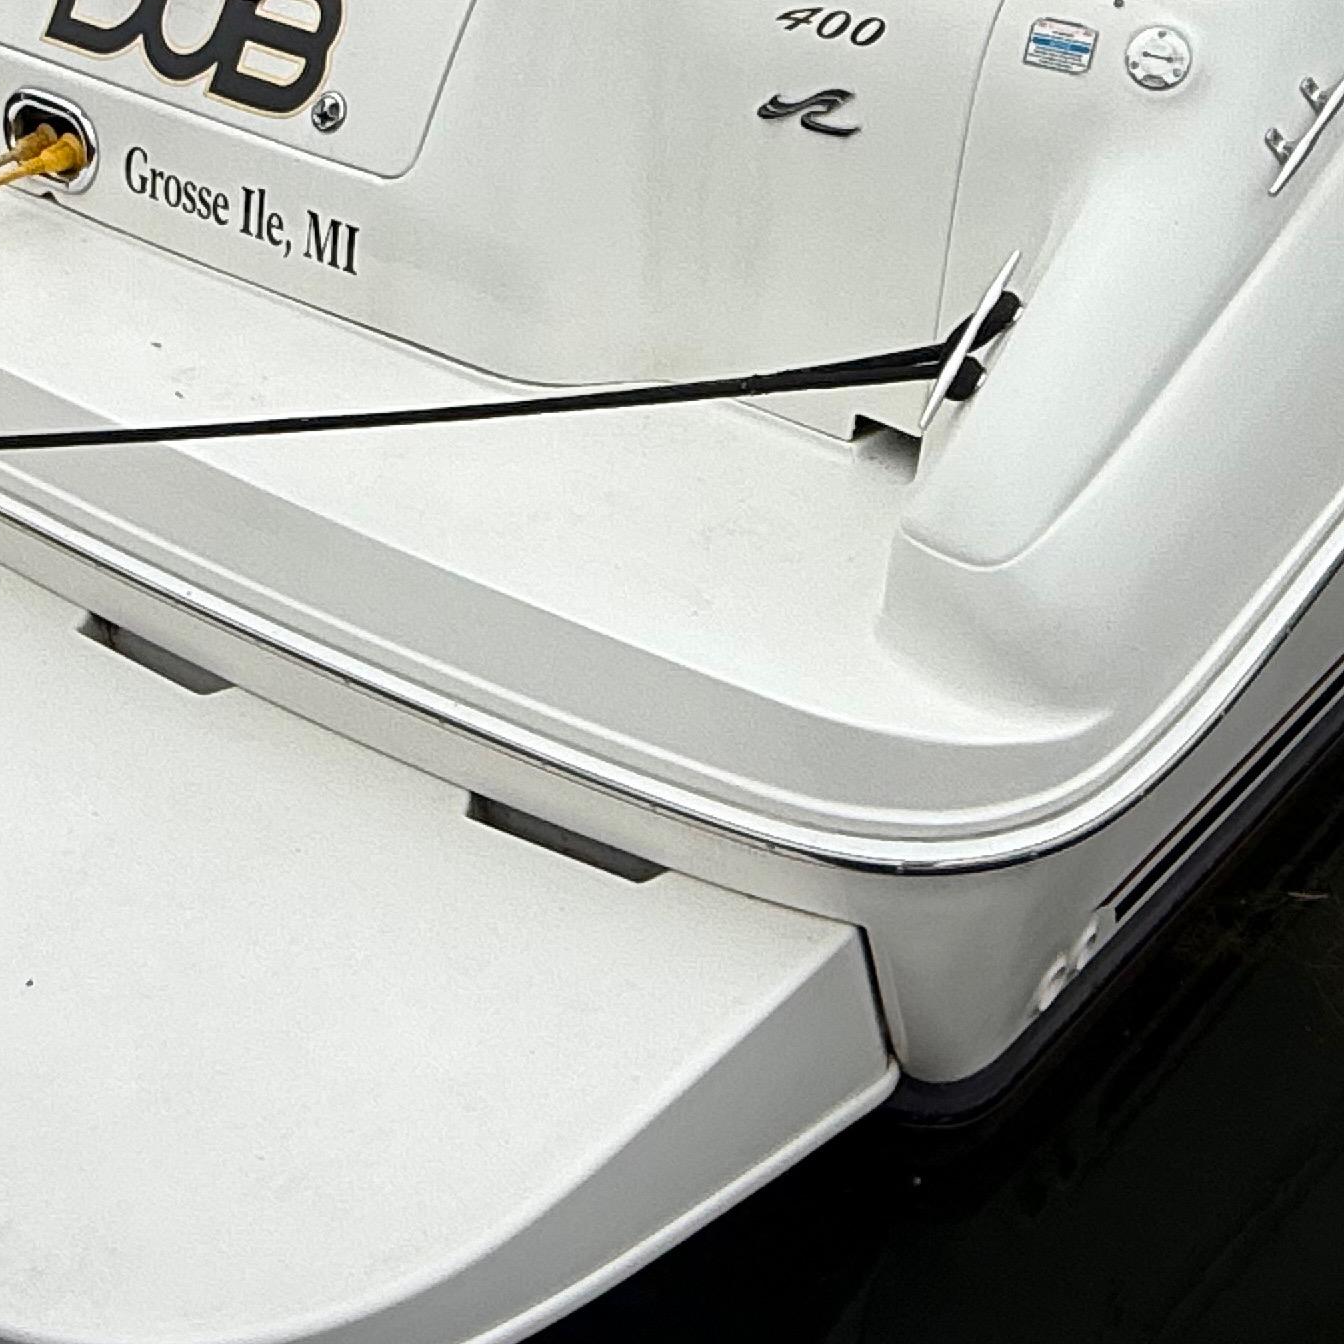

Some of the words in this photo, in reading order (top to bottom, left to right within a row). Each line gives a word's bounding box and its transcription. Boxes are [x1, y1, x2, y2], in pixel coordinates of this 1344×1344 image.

[775, 6, 886, 47] 400
[124, 146, 230, 226] Grosse
[239, 186, 292, 258] Ile,
[302, 209, 360, 276] MI
